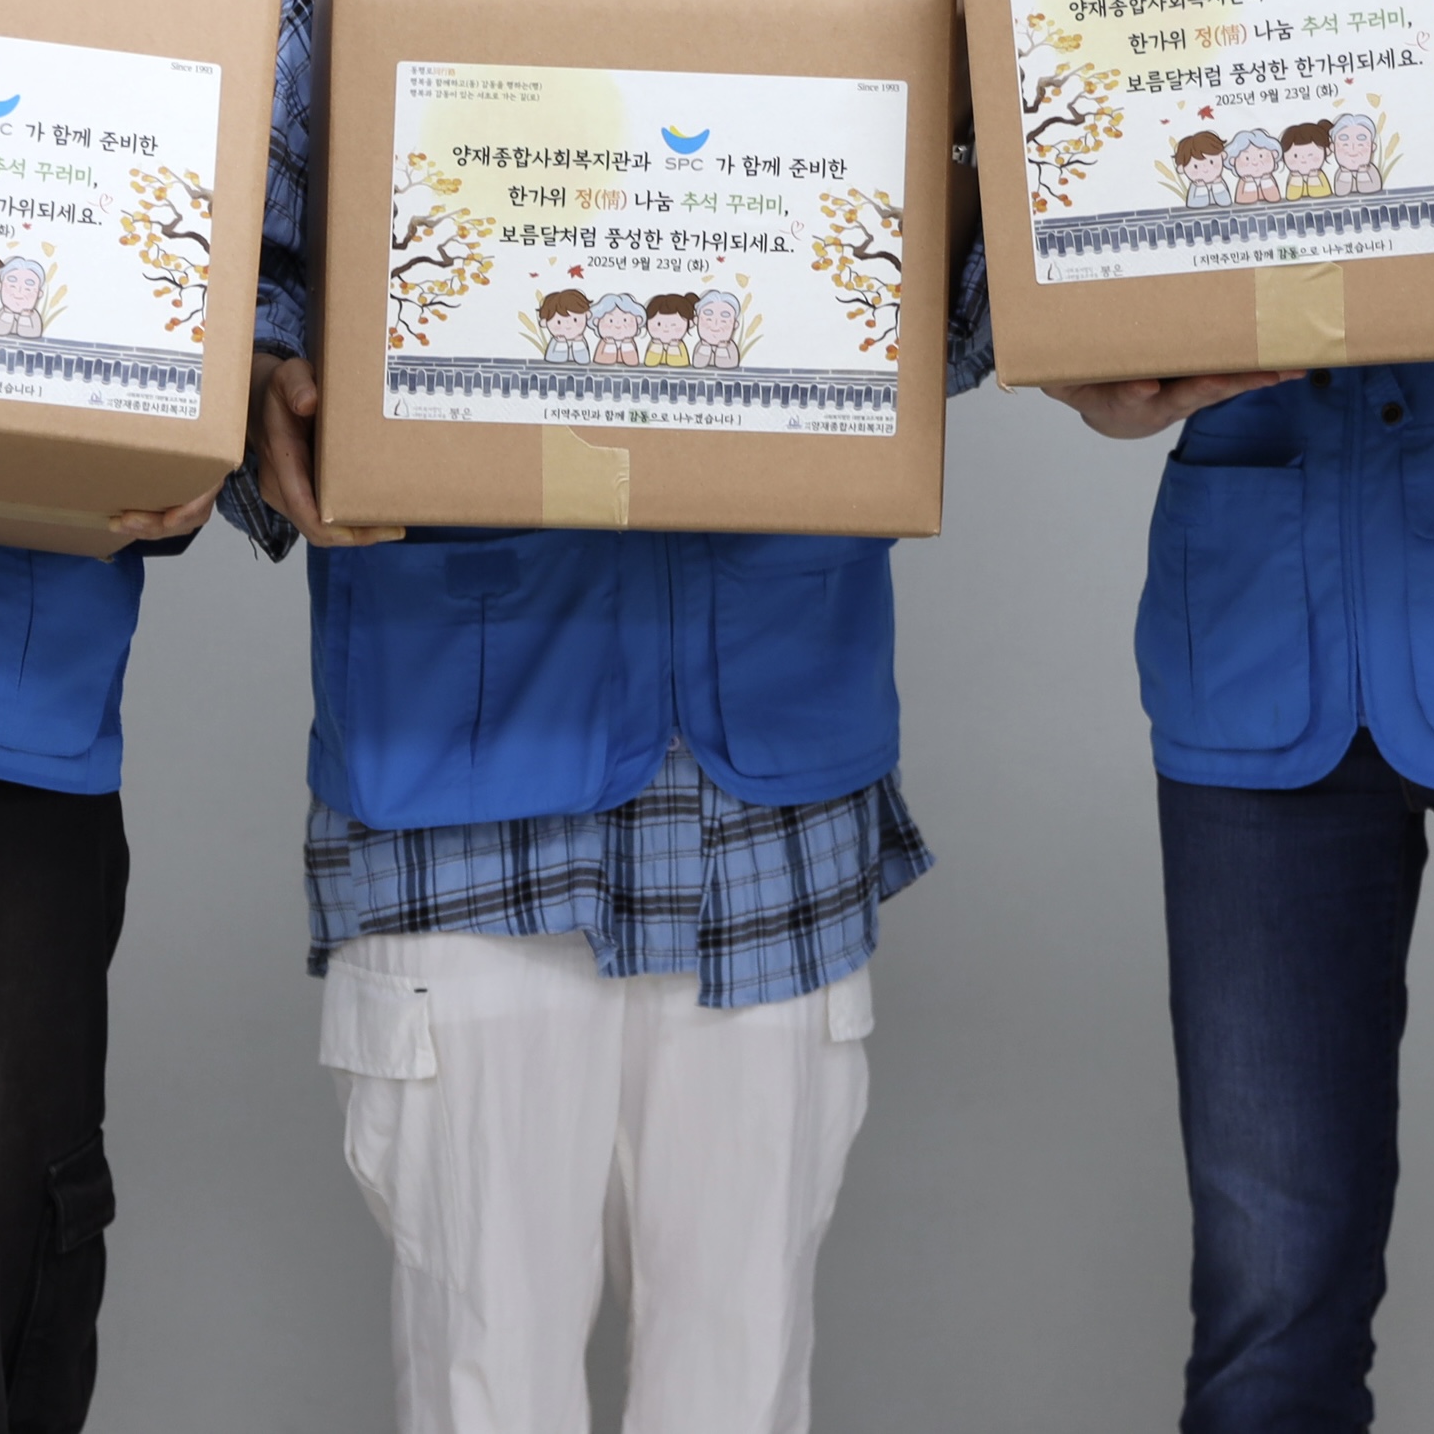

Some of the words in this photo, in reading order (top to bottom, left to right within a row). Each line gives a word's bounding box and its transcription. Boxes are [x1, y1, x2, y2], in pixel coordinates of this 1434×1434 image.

[1128, 28, 1186, 55] 한가위
[1194, 23, 1247, 49] 정(情)
[1254, 19, 1294, 41] 나눔
[1301, 13, 1339, 37] 추석
[1347, 6, 1413, 33] 꾸러미,
[171, 62, 193, 72] Since
[195, 65, 213, 74] 1993
[1126, 64, 1221, 94] 보름달처럼
[1229, 58, 1288, 85] 풍성한
[1294, 48, 1423, 78] 한가위되세요.
[857, 83, 879, 92] Since
[882, 84, 900, 92] 1993
[1215, 90, 1255, 106] 2025년
[1259, 88, 1279, 103] 9월
[1285, 85, 1310, 100] 23일
[1316, 83, 1339, 99] (화)
[25, 121, 45, 142] 가
[52, 124, 91, 148] 함께
[99, 131, 158, 157] 준비한
[34, 162, 98, 189] 꾸러미,
[452, 145, 652, 172] 양재종합사회복지관과
[665, 157, 703, 172] SPC
[716, 154, 735, 175] 가
[742, 155, 780, 177] 함께
[789, 158, 847, 180] 준비한
[508, 185, 566, 208] 한가위
[575, 188, 627, 210] 정(情)
[635, 190, 674, 212] 나눔
[680, 191, 717, 214] 추석
[726, 194, 789, 217] 꾸러미,
[499, 224, 596, 248] 보름달처럼
[604, 228, 663, 250] 풍성한
[670, 230, 794, 253] 한가위되세요.
[587, 256, 627, 270] 2025년
[632, 257, 651, 271] 9월
[656, 258, 682, 272] 23일
[687, 259, 710, 272] (화)
[1200, 250, 1251, 266] 지역주민과
[1253, 248, 1274, 262] 함께
[1278, 246, 1319, 260] 감동으로
[1322, 240, 1385, 255] 나누겠습니다
[551, 408, 601, 421] 지역주민과
[605, 410, 625, 422] 함께
[629, 411, 669, 423] 감동으로
[673, 412, 734, 425] 나누겠습니다
